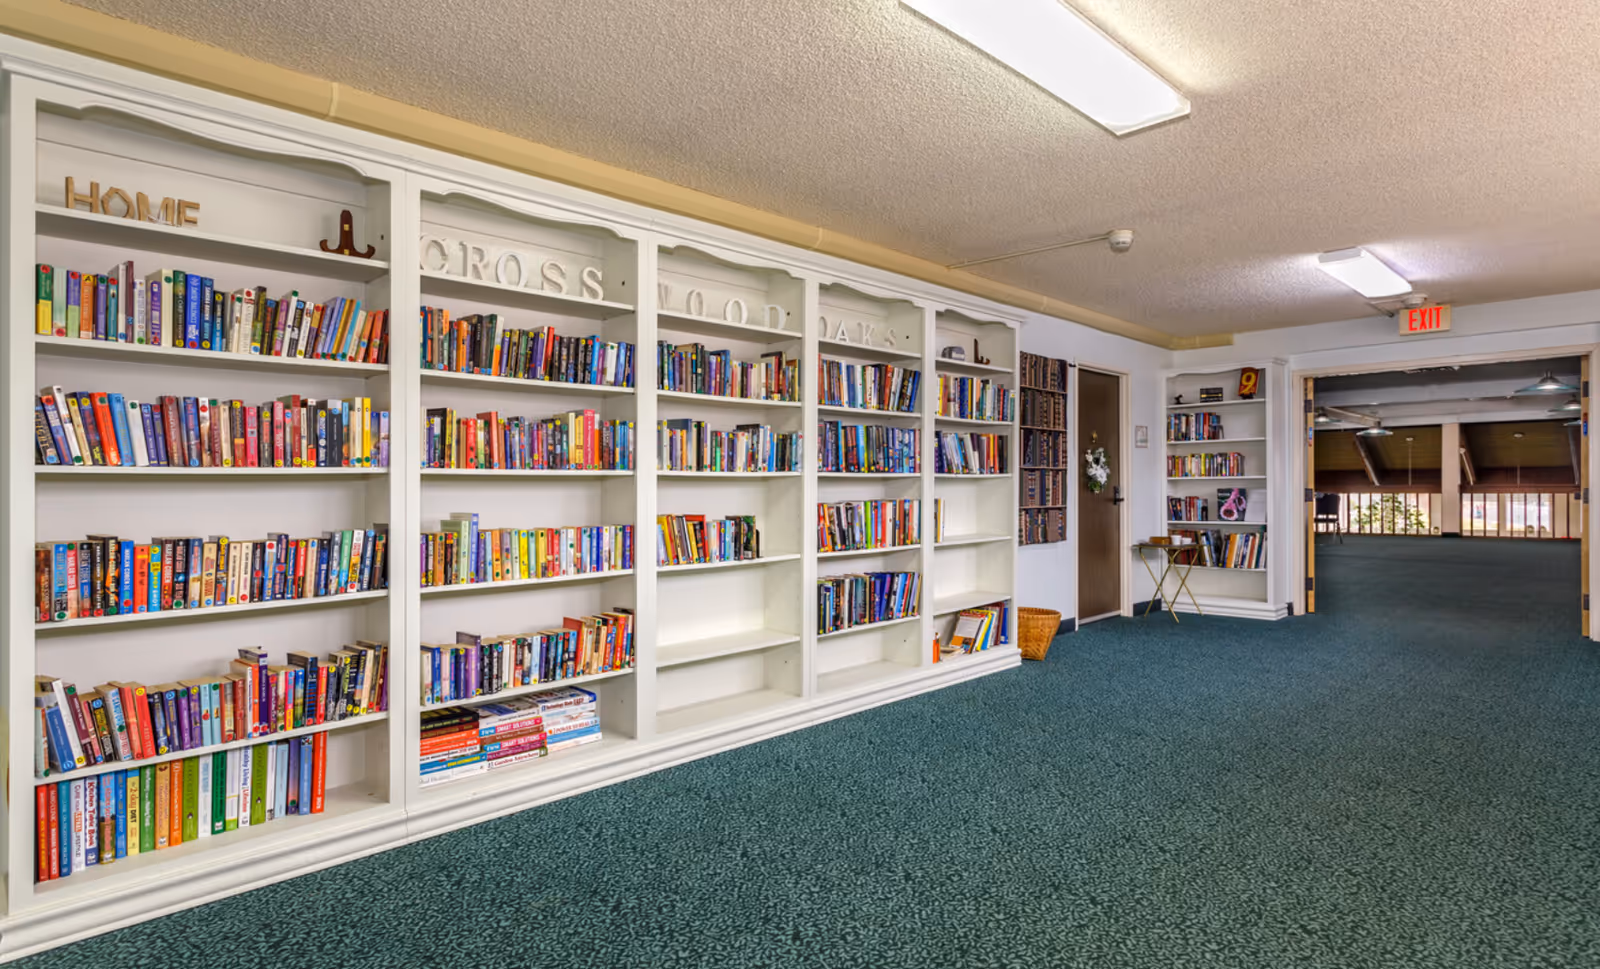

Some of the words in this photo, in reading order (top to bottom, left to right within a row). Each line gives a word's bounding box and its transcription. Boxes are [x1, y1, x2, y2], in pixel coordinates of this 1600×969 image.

[65, 176, 200, 228] HOME
[419, 233, 604, 301] CROSS
[1408, 306, 1443, 331] EXIT
[164, 543, 172, 565] HARLAN
[164, 565, 172, 583] COBEN
[497, 725, 512, 733] SMART
[513, 719, 535, 729] SOLUTIONS
[518, 734, 540, 744] SOLUTIONS
